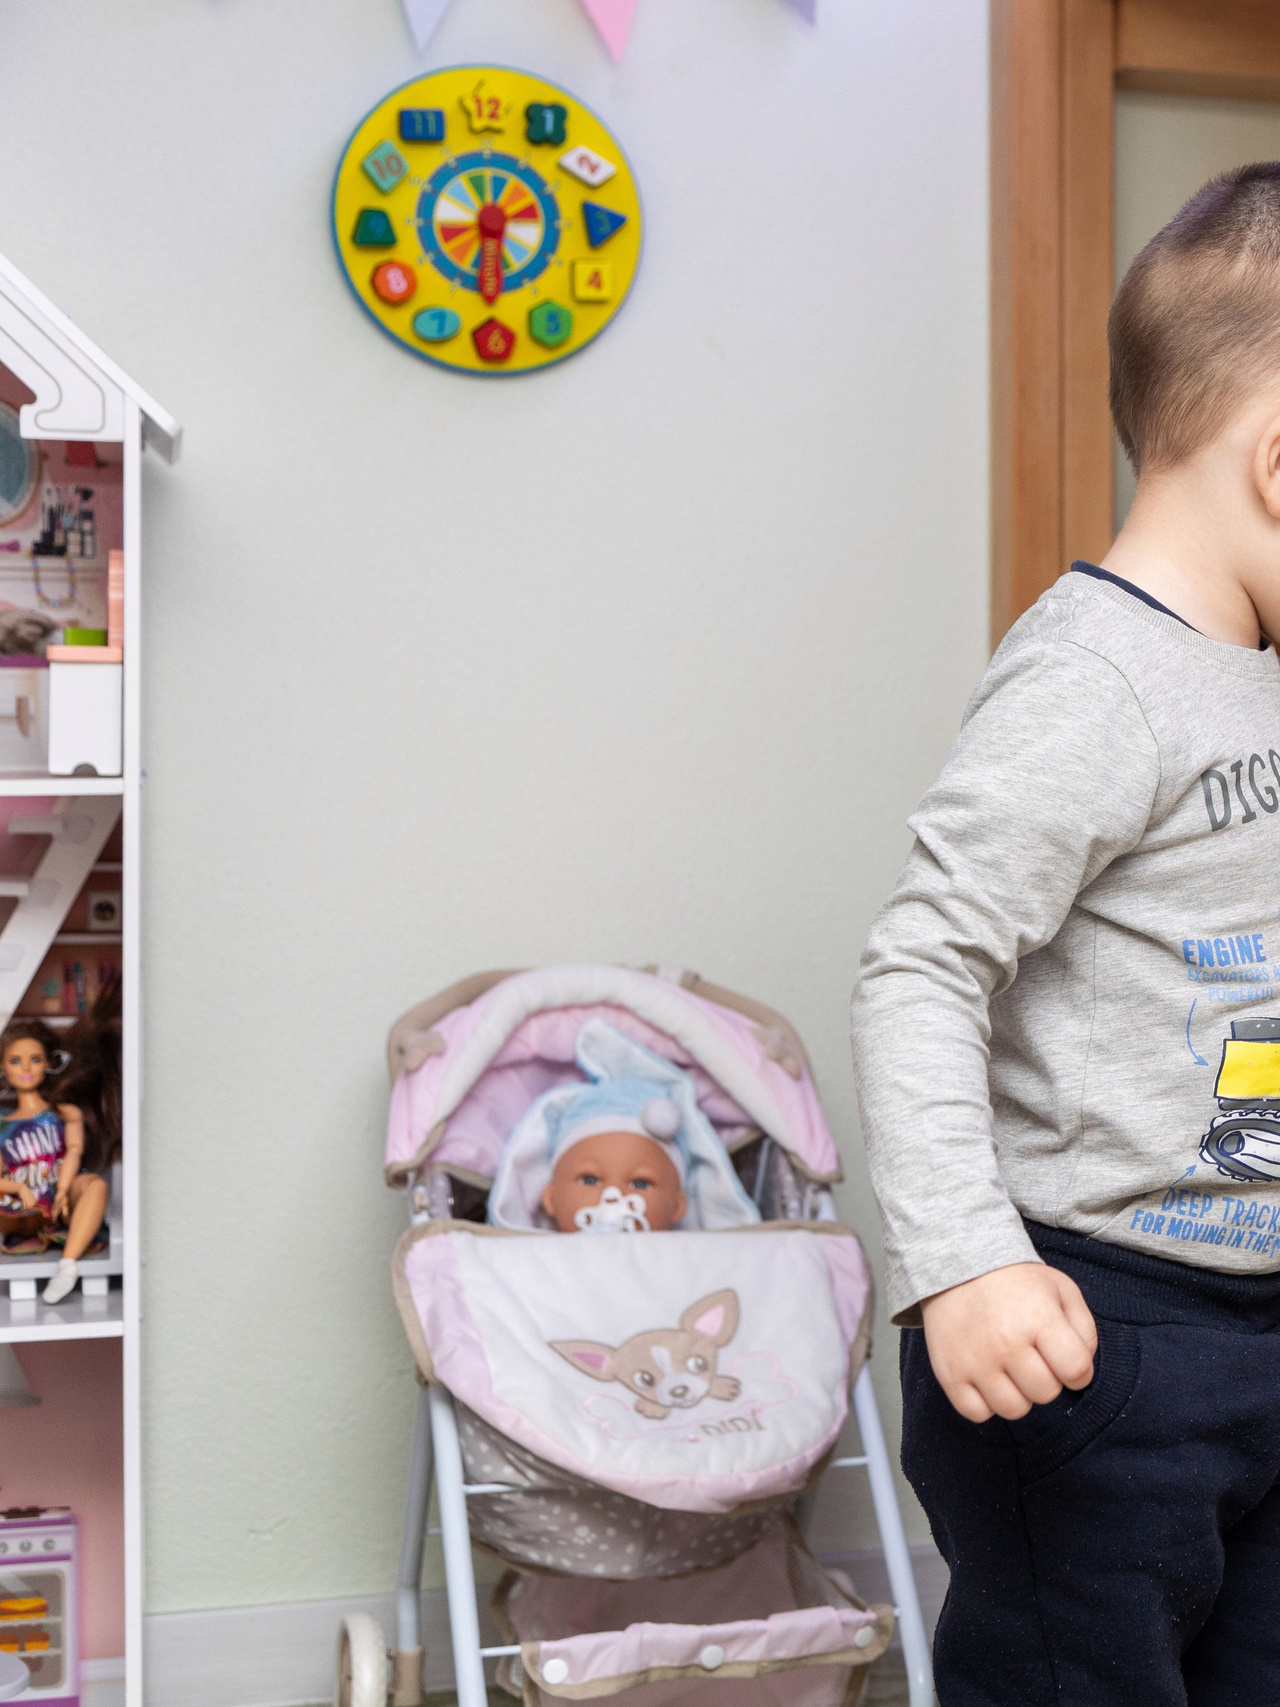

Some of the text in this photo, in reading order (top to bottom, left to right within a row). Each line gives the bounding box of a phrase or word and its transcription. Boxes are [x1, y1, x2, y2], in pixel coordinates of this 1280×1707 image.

[474, 96, 501, 120] 12
[543, 108, 555, 134] 1
[413, 111, 437, 134] 11
[371, 153, 404, 181] 10
[576, 153, 601, 175] 2
[368, 214, 386, 241] 9
[385, 266, 409, 295] 8
[588, 268, 604, 290] 4
[430, 311, 449, 335] 7
[545, 309, 562, 336] 5
[486, 329, 507, 355] 6
[1182, 933, 1267, 967] ENGINE
[1187, 966, 1270, 983] EXCAVATORS
[1161, 1187, 1213, 1219] DEEP
[1130, 1209, 1166, 1235] FOR
[1166, 1216, 1228, 1246] MOVING
[1224, 1228, 1246, 1249] IN
[1244, 1230, 1275, 1254] THE
